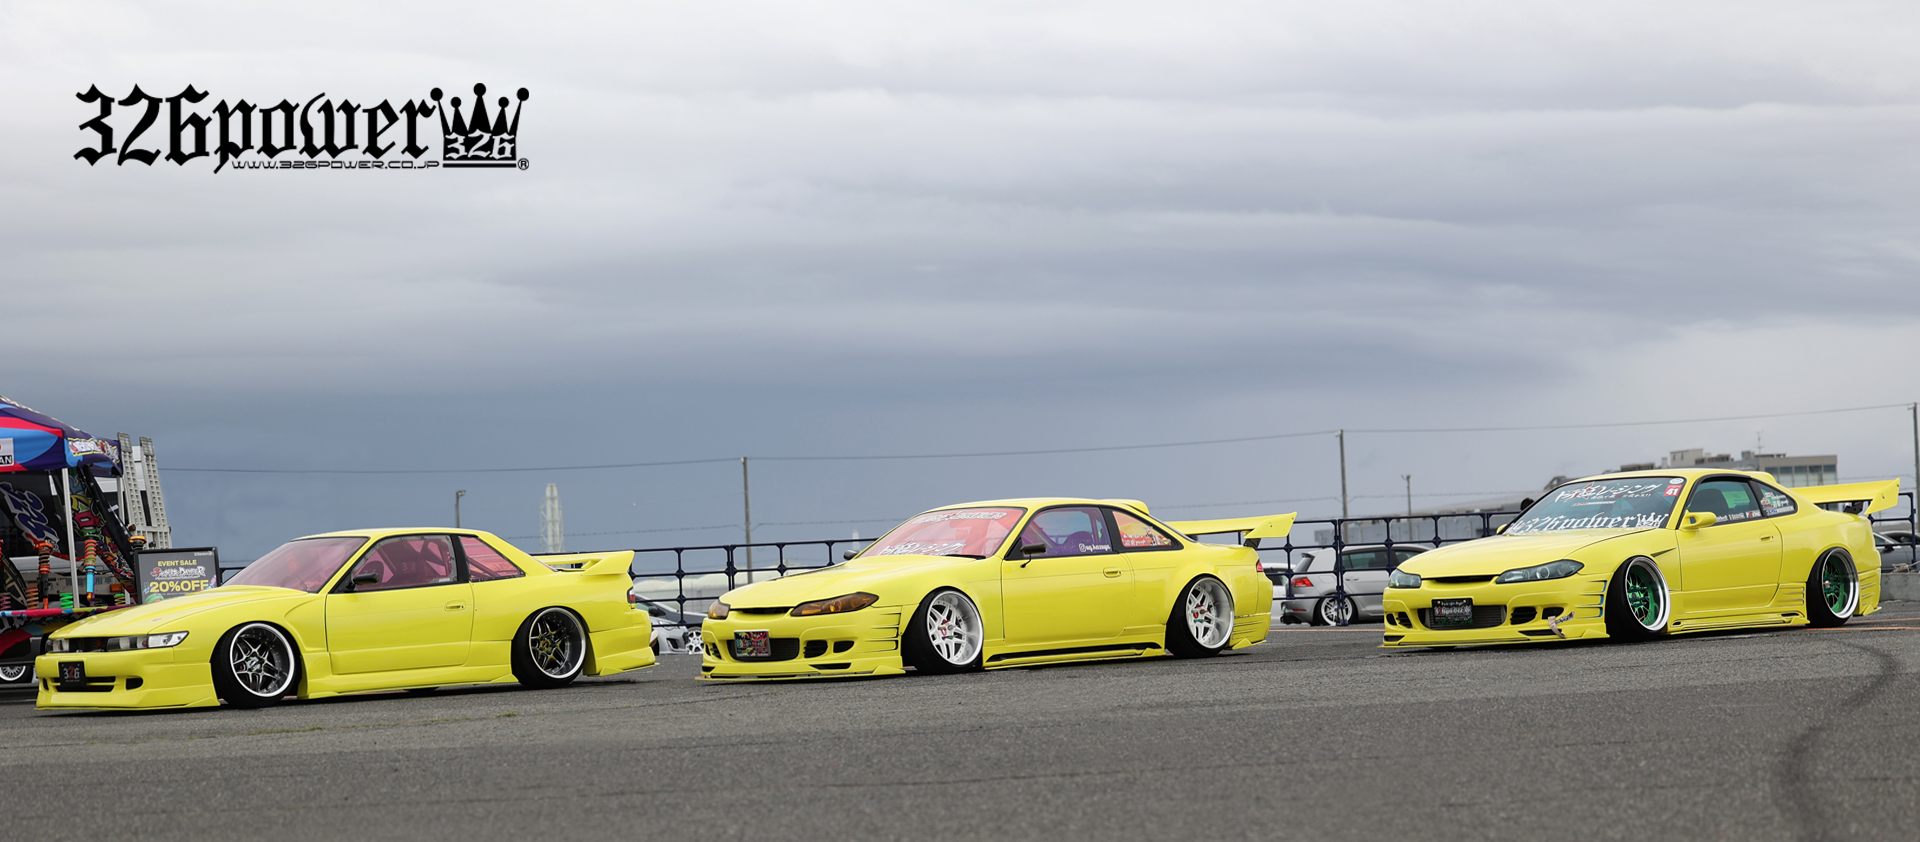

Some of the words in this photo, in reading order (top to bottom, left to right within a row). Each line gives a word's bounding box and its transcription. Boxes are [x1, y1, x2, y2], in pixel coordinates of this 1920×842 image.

[1666, 488, 1679, 496] 41
[149, 579, 209, 593] 20%OFF
[63, 666, 80, 680] 326
